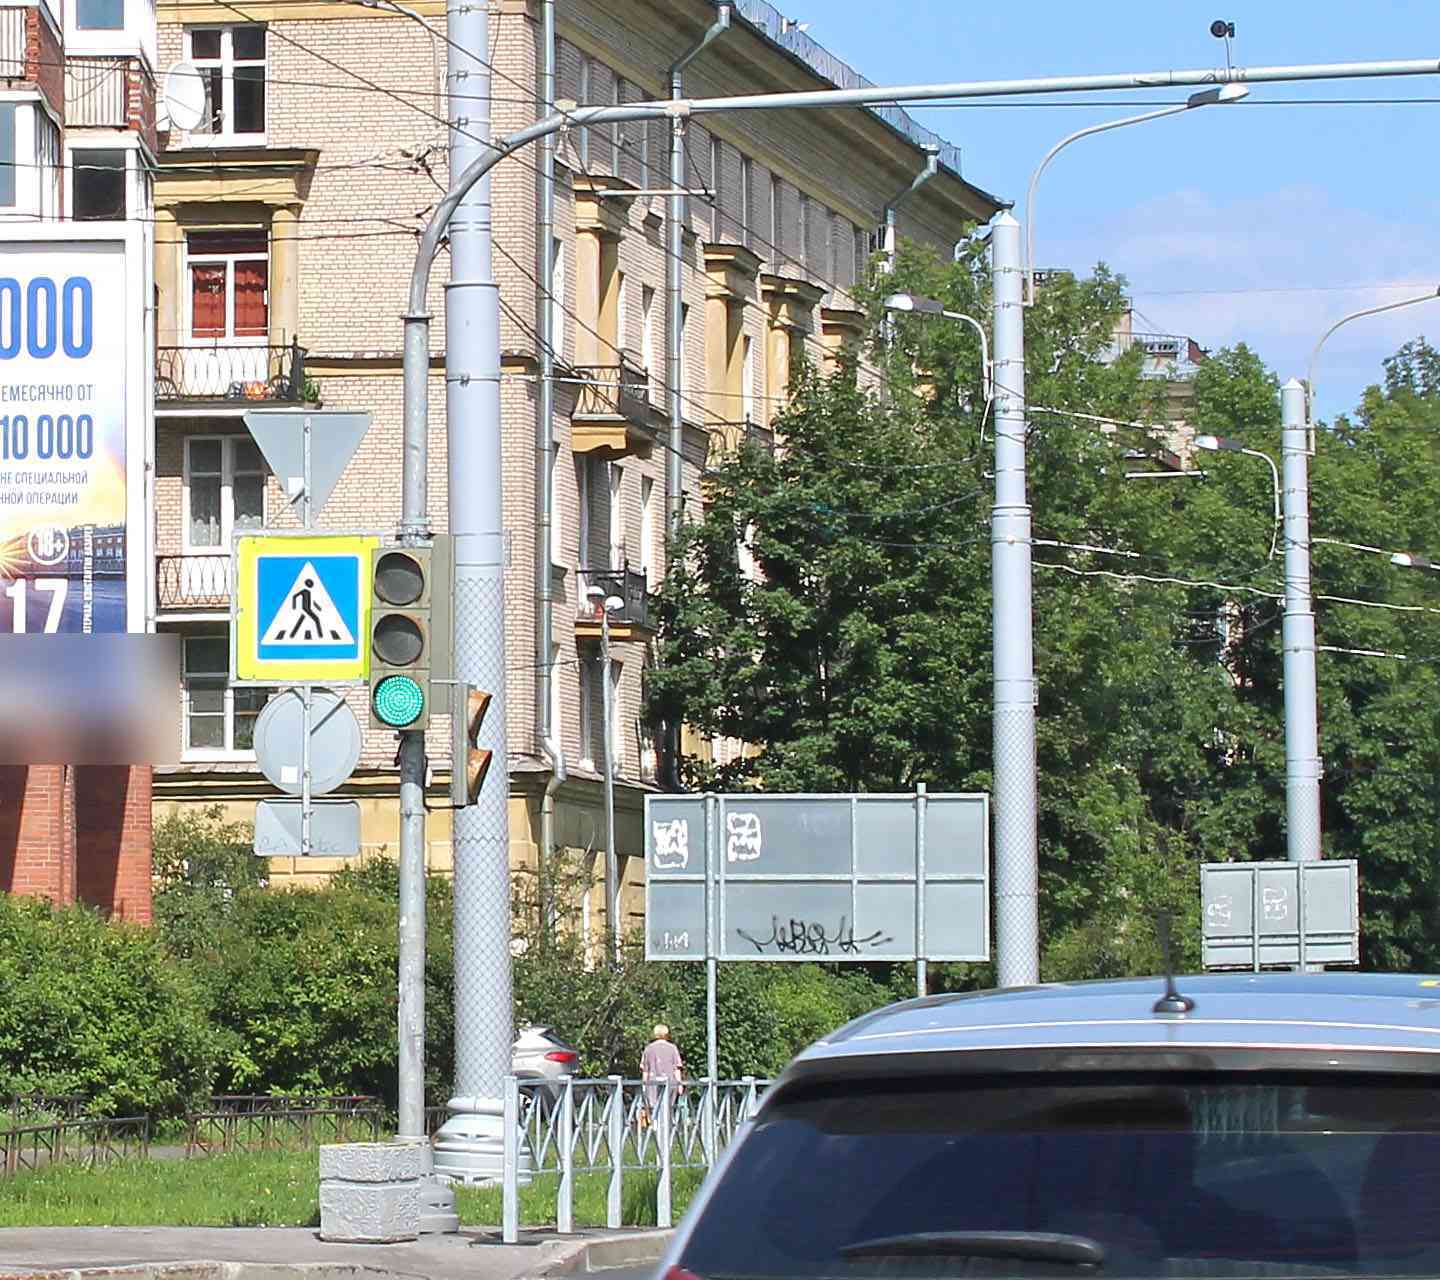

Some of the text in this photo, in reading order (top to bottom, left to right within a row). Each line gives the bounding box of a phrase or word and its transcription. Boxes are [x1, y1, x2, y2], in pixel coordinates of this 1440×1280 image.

[77, 384, 94, 401] ОТ
[37, 414, 93, 460] 000
[15, 470, 88, 485] СПЕЦИАЛЬНОЙ
[26, 491, 79, 505] ОПЕРАЦИИ
